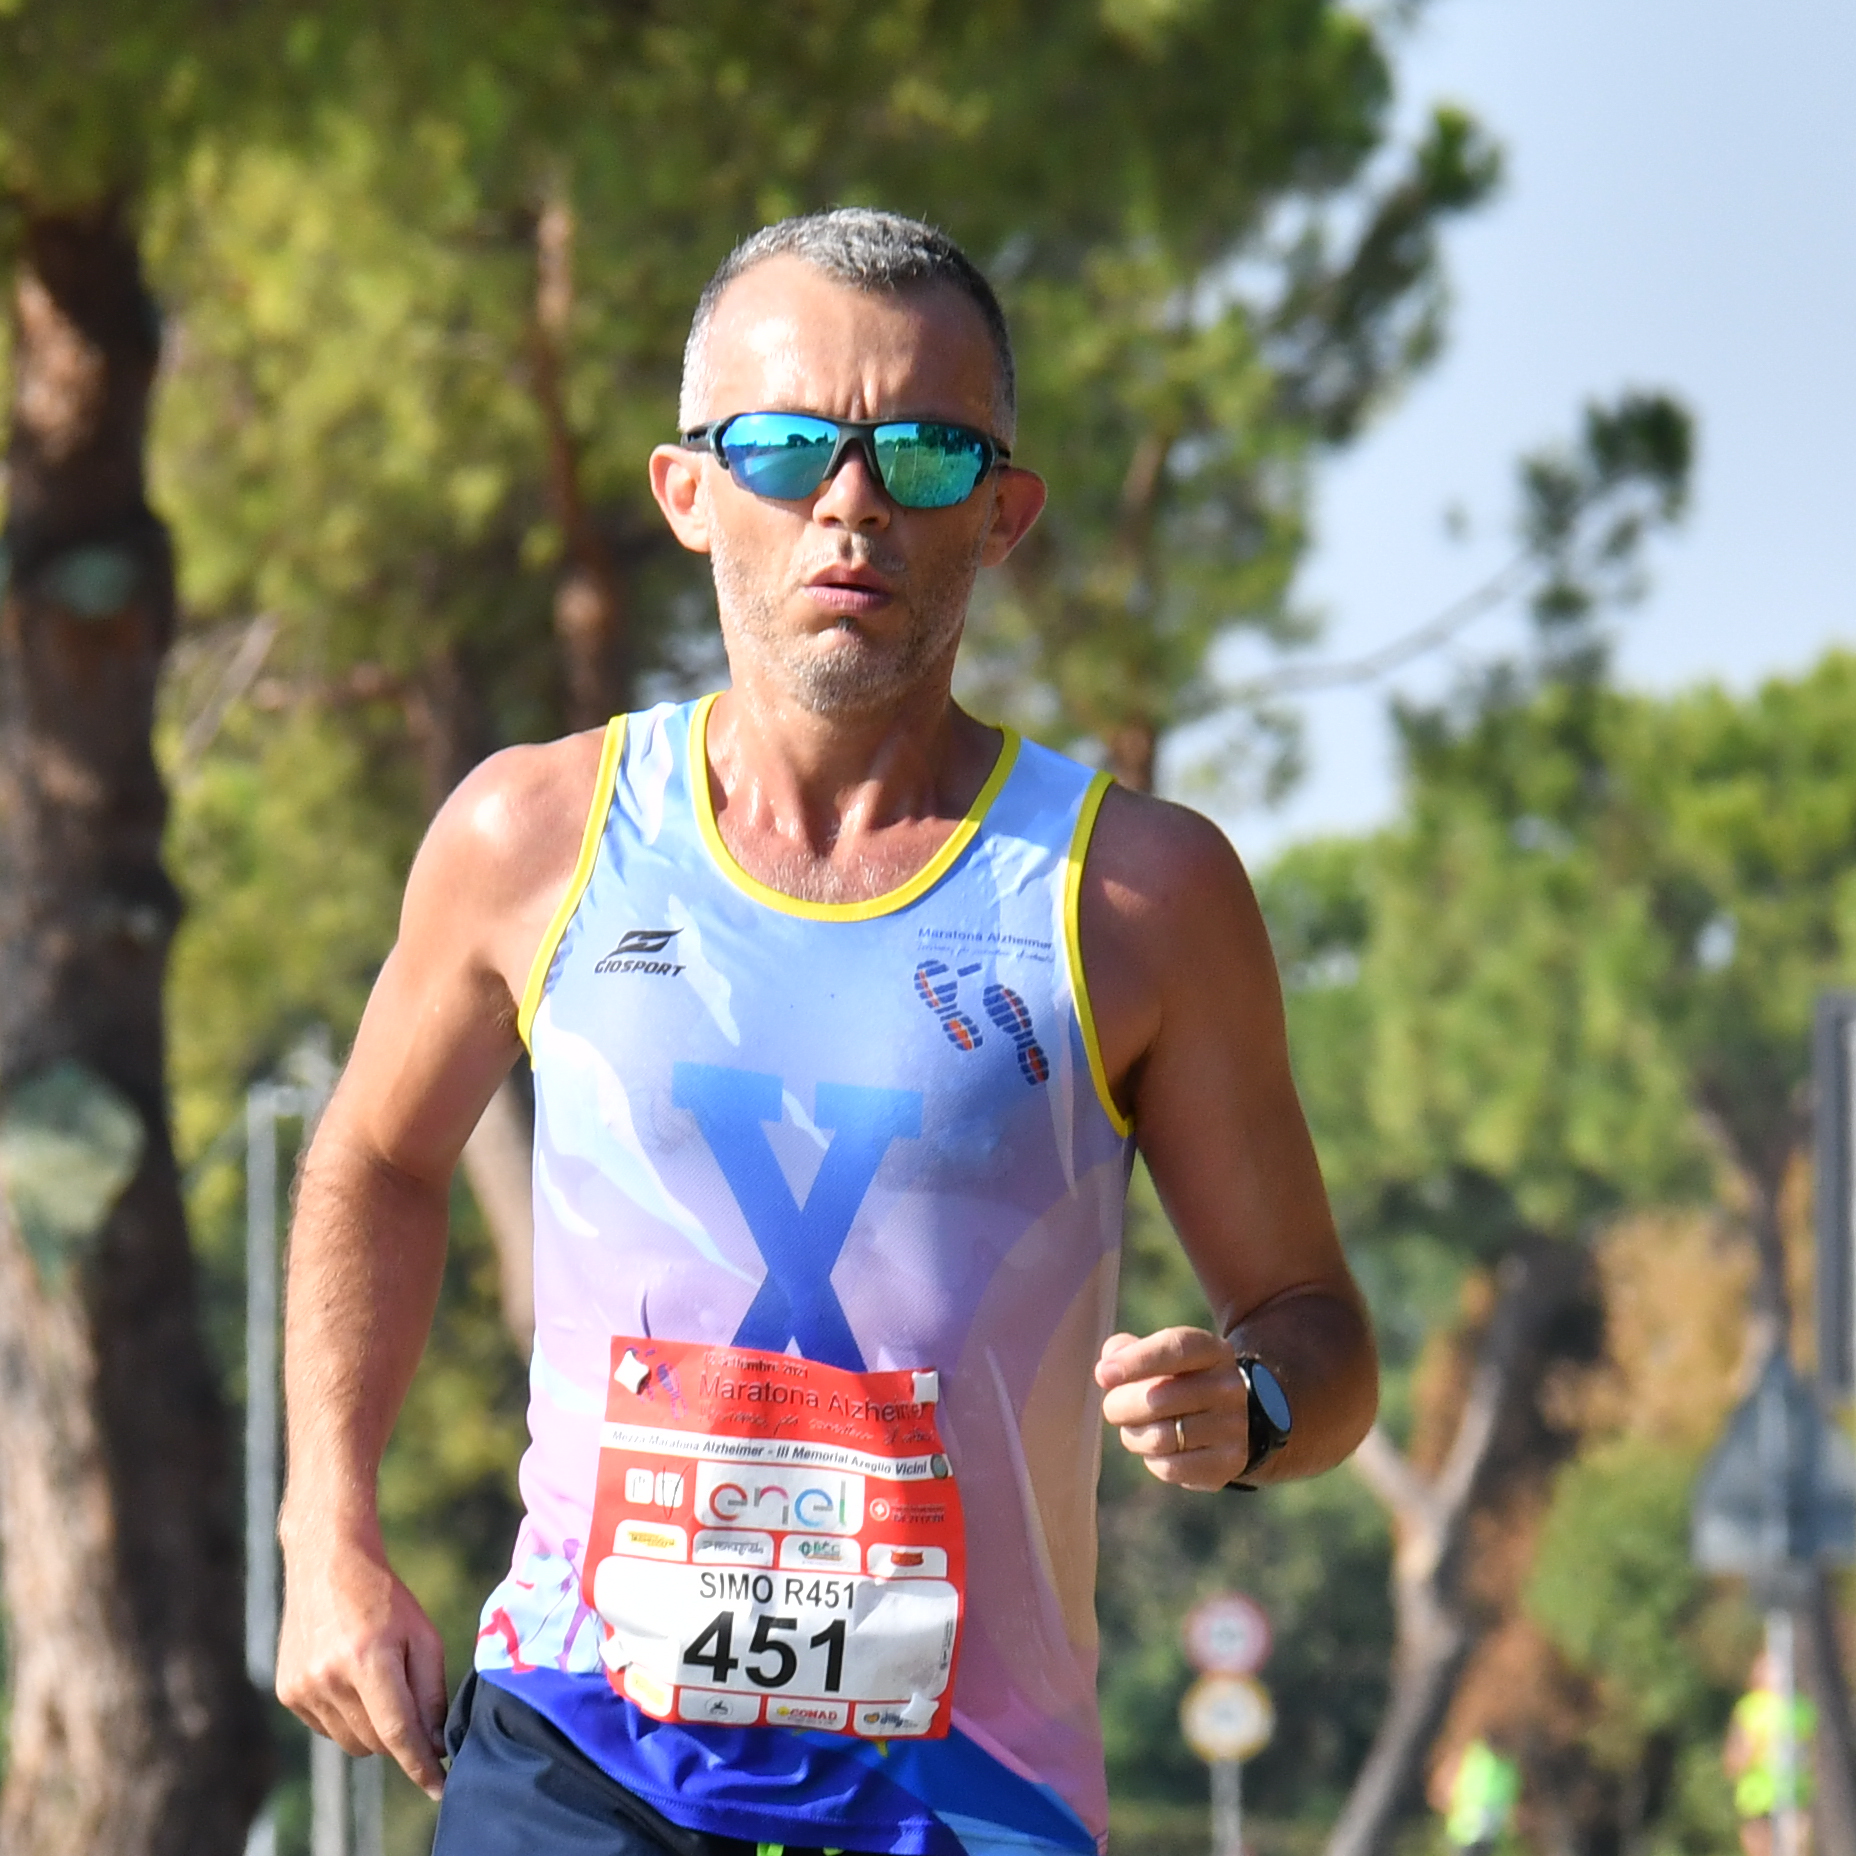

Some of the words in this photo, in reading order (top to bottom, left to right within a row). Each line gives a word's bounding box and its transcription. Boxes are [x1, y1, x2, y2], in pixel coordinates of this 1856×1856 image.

[918, 928, 983, 942] Maratona
[987, 932, 1052, 950] Alzheimer
[594, 960, 686, 977] GIOSPORT
[699, 1371, 820, 1408] Maratona
[703, 1440, 764, 1457] Alzheimer
[776, 1445, 789, 1459] III
[792, 1446, 849, 1464] Memorial
[851, 1456, 892, 1475] Azeglio
[895, 1461, 927, 1475] Vicini
[709, 1480, 846, 1528] enel
[700, 1572, 773, 1604] SIMO
[785, 1578, 854, 1610] R451
[683, 1611, 846, 1693] 451
[790, 1708, 838, 1721] CONAD
